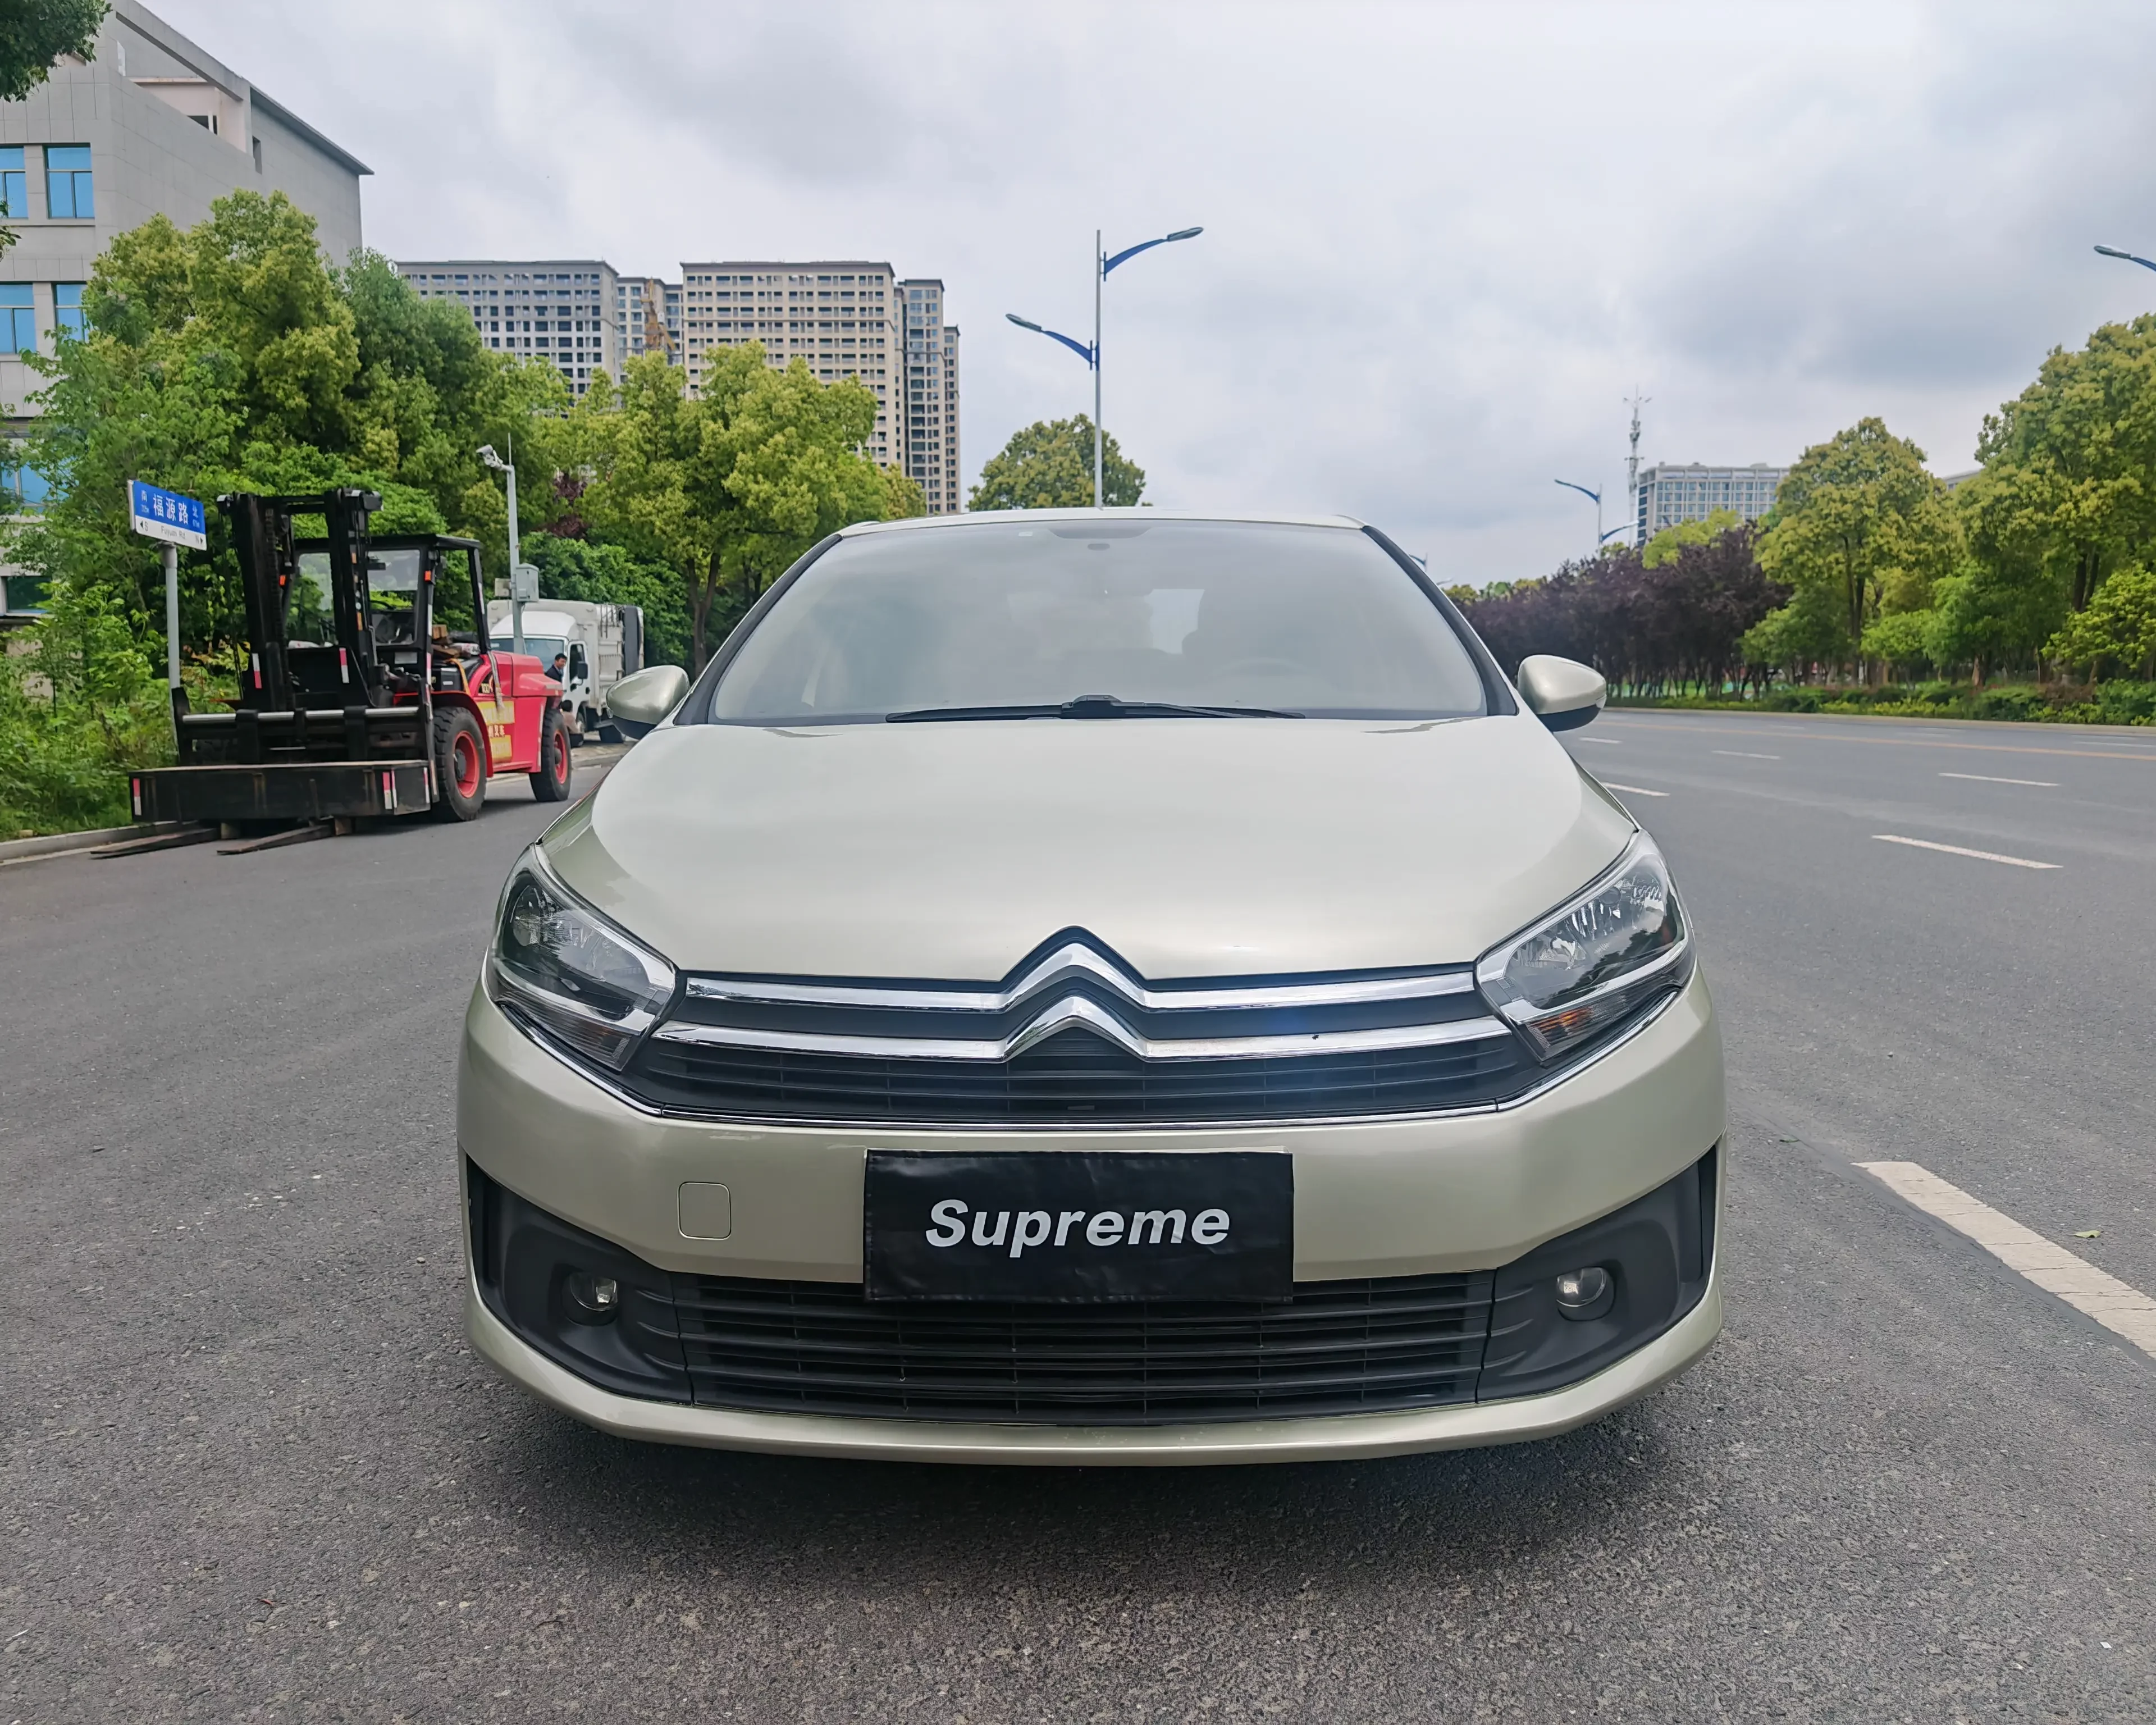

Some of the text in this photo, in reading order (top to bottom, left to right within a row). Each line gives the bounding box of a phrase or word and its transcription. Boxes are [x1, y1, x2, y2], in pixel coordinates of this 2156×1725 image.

[153, 493, 189, 525] 福源路
[144, 521, 149, 532] S
[925, 1199, 1230, 1258] Supreme
